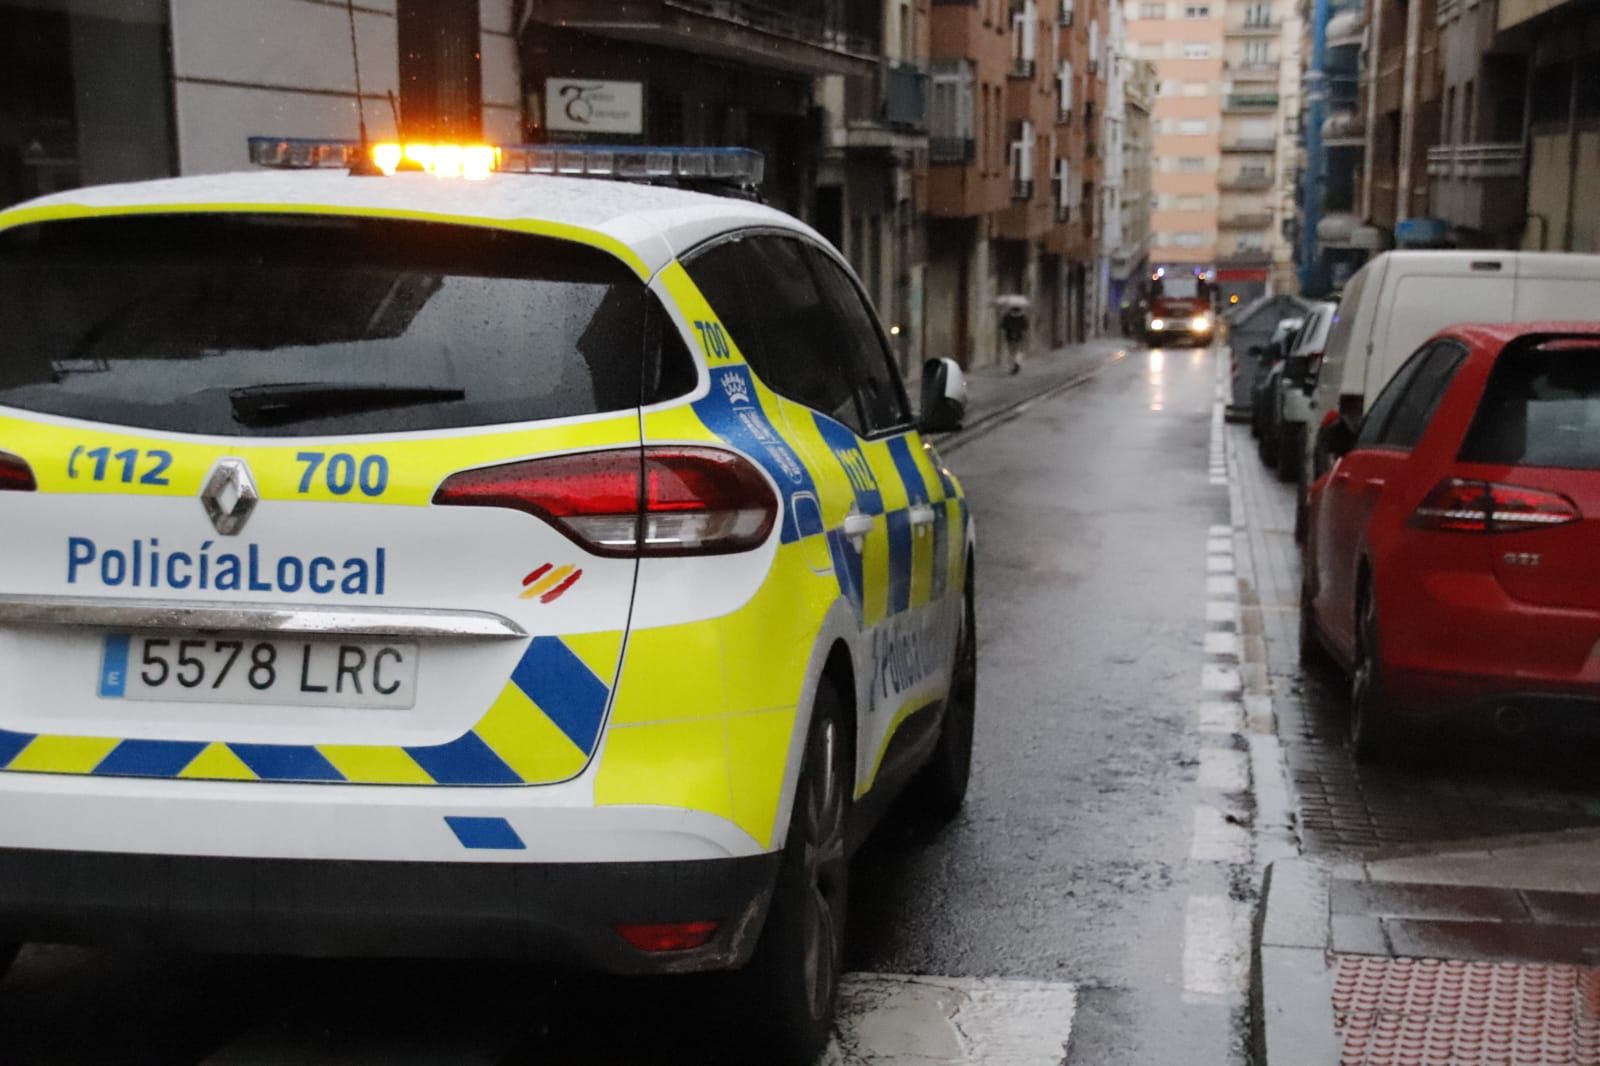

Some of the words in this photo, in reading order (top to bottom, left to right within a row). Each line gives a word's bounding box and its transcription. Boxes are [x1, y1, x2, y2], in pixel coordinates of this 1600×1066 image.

[694, 320, 730, 359] 700
[86, 446, 173, 486] 112
[296, 451, 389, 497] 700
[66, 537, 386, 596] PolicíaLocal
[106, 671, 120, 686] E
[140, 638, 278, 691] 5578
[299, 644, 403, 695] LRC
